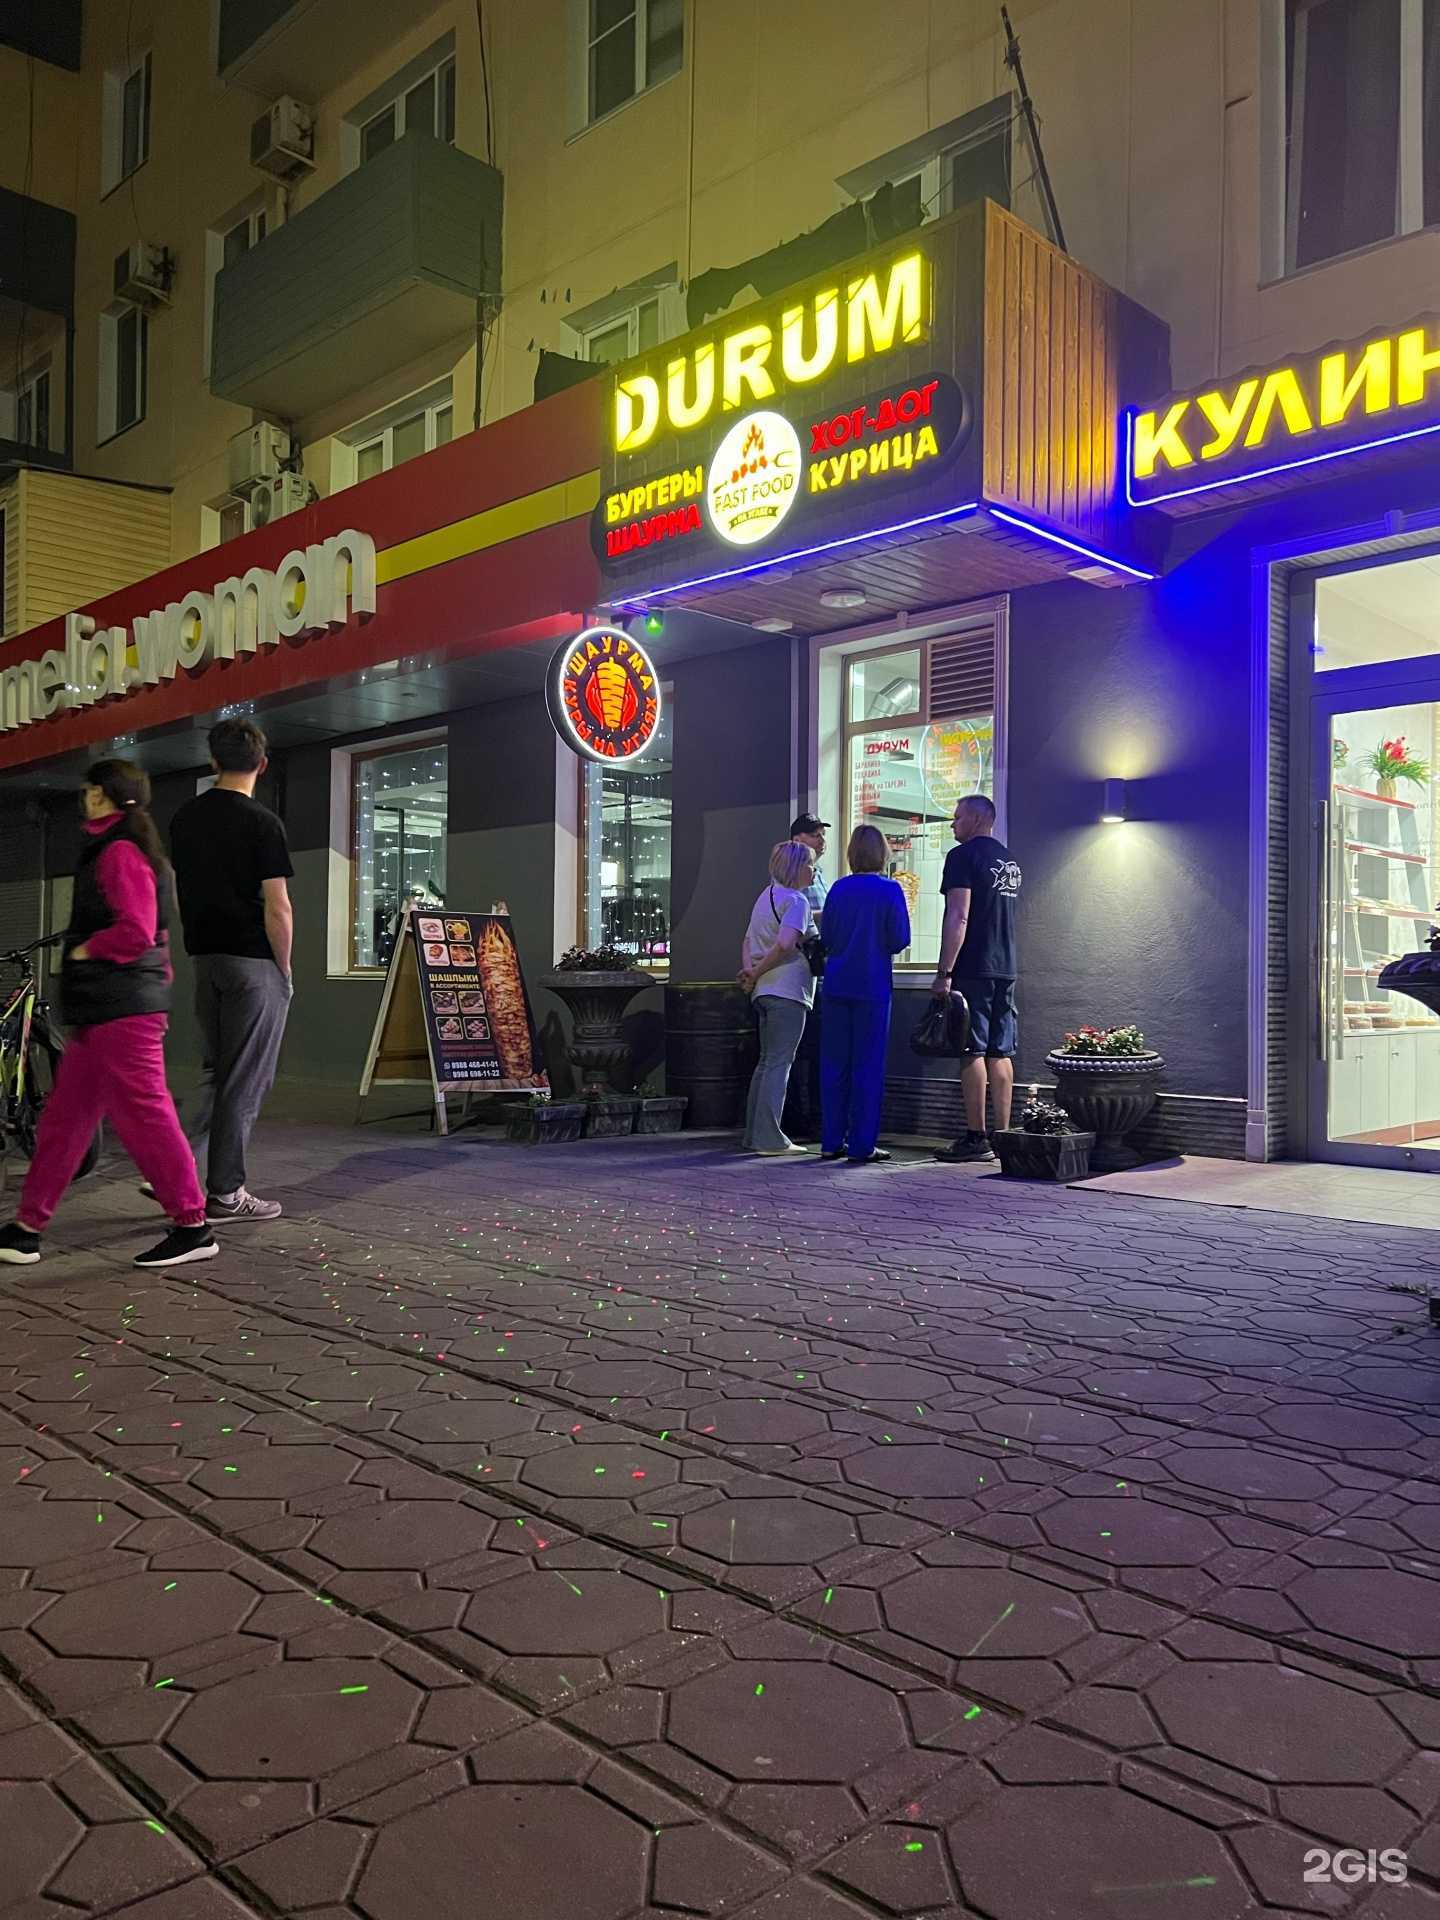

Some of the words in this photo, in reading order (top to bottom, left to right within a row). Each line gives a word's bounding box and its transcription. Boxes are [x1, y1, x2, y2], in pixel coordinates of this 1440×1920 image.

[616, 253, 922, 453] DURUM
[810, 380, 939, 454] ХОТ-ДОГ
[1134, 328, 1440, 479] КУЛИН
[809, 425, 939, 493] КУРИЦА
[606, 465, 703, 523] БУРГЕРЫ
[715, 487, 747, 513] FAST
[752, 473, 794, 501] FOOD
[606, 503, 703, 557] ШАУРМА
[568, 636, 654, 691] ШАУРМА
[564, 679, 592, 741] КУРЫ
[593, 738, 617, 757] НА
[621, 696, 657, 756] УГЛЯХ
[867, 738, 909, 755] ДУРУМ
[429, 973, 479, 982] ШАШЛЫКИ
